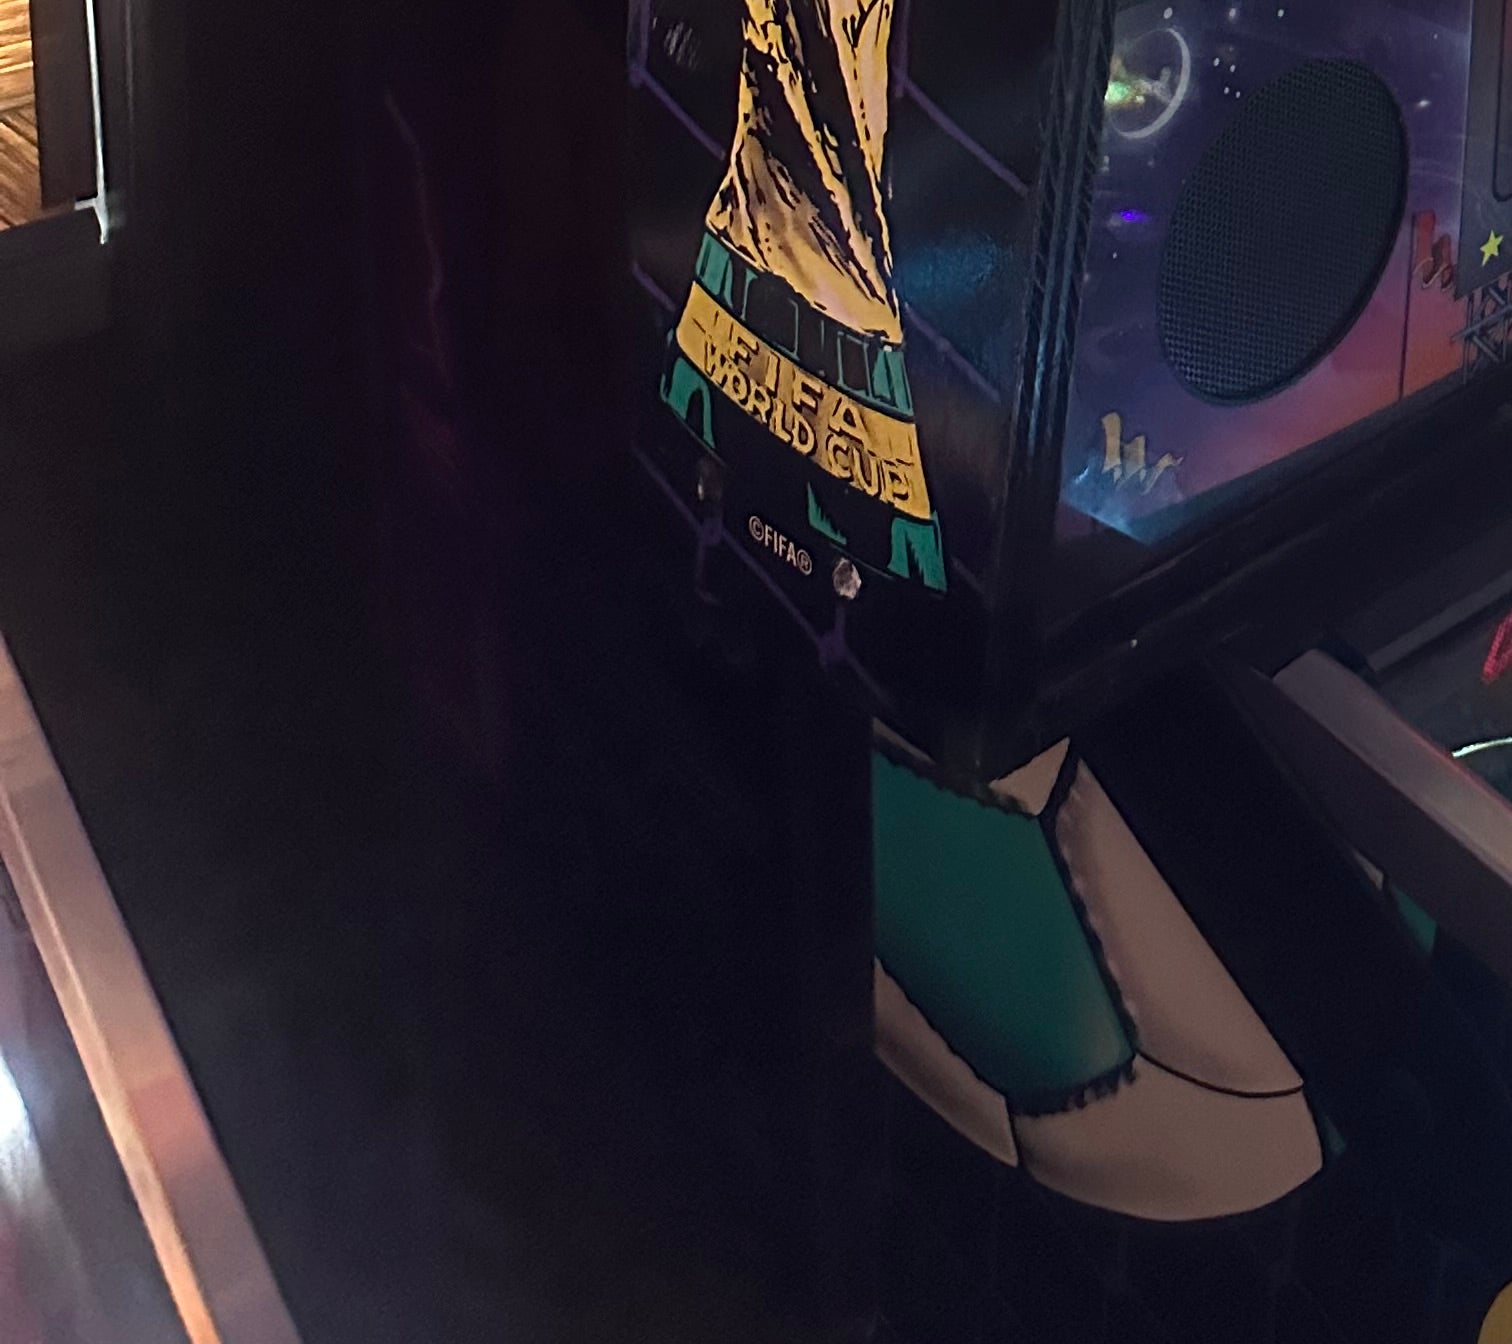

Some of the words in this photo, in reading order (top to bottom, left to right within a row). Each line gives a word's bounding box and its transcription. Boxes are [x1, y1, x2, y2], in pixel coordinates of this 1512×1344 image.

[704, 337, 818, 457] WORLD
[826, 432, 914, 505] CUP
[729, 329, 871, 447] FIFA
